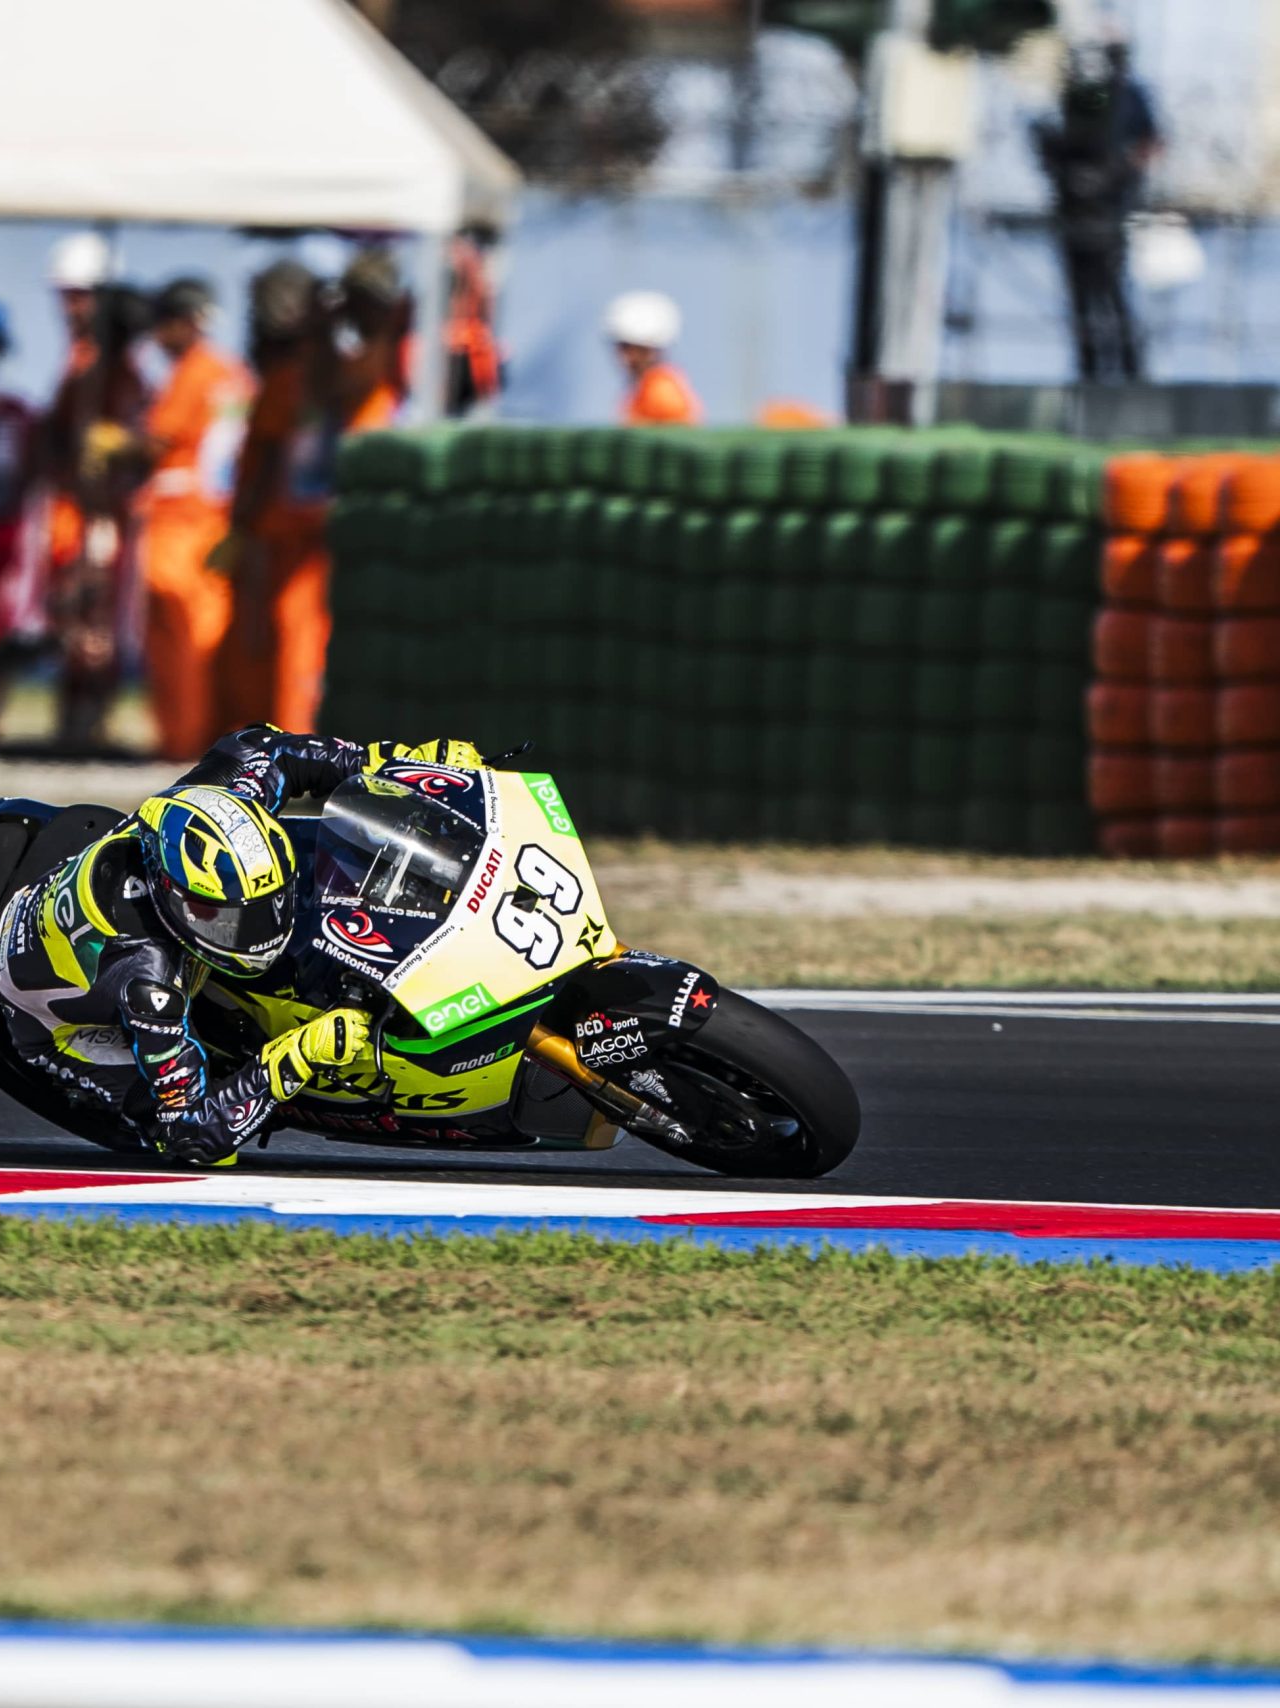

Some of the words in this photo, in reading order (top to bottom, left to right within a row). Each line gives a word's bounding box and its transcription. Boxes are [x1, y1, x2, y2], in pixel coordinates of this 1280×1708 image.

[529, 778, 571, 832] enel
[321, 895, 364, 907] WRS
[467, 848, 503, 914] DUCATI
[370, 904, 405, 916] IVECO
[312, 938, 325, 950] el
[325, 943, 385, 982] Motorista
[393, 953, 423, 980] Printing
[421, 924, 456, 954] Emotions
[424, 985, 490, 1032] enel
[668, 972, 701, 1028] DALLAS
[575, 1018, 604, 1038] BCD
[579, 1031, 645, 1058] LAGOM
[585, 1045, 648, 1069] GROUP
